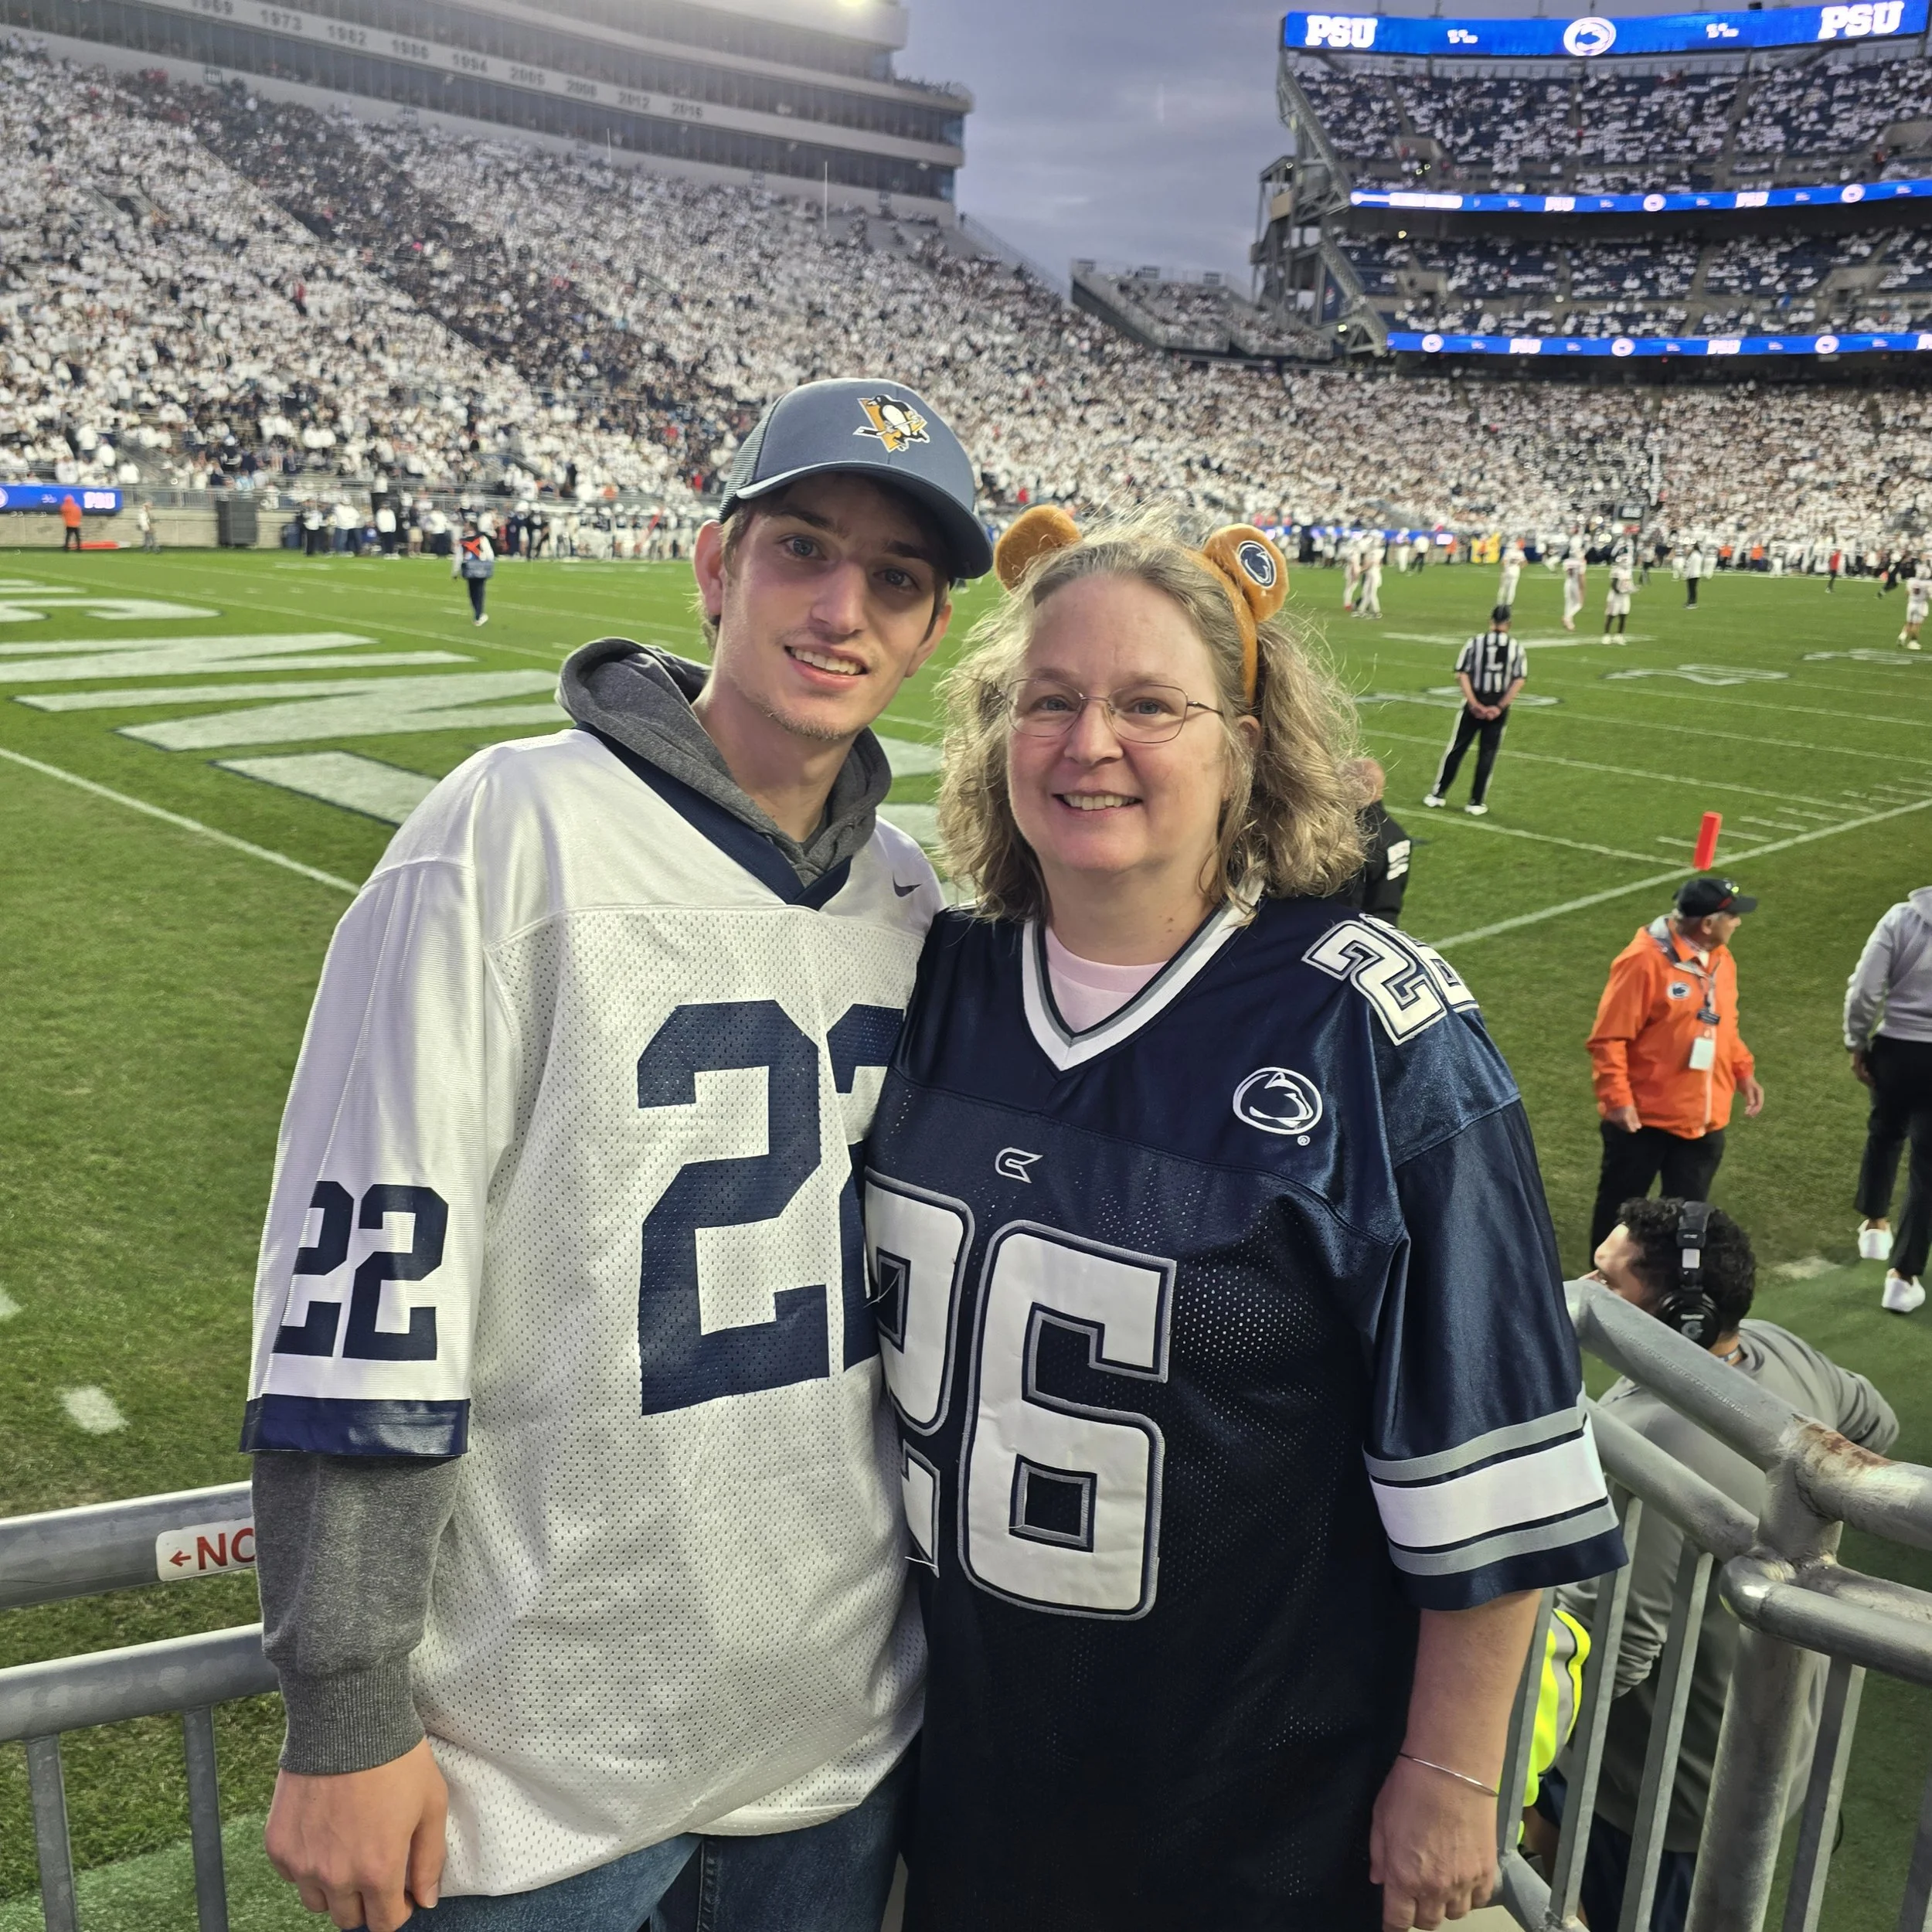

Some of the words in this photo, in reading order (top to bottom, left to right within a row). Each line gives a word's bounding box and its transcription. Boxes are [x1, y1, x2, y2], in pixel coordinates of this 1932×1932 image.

[1305, 15, 1378, 48] PSU
[1818, 1, 1905, 39] PSU
[618, 90, 651, 110] 2012
[1485, 645, 1504, 671] L
[272, 1180, 449, 1361] 22
